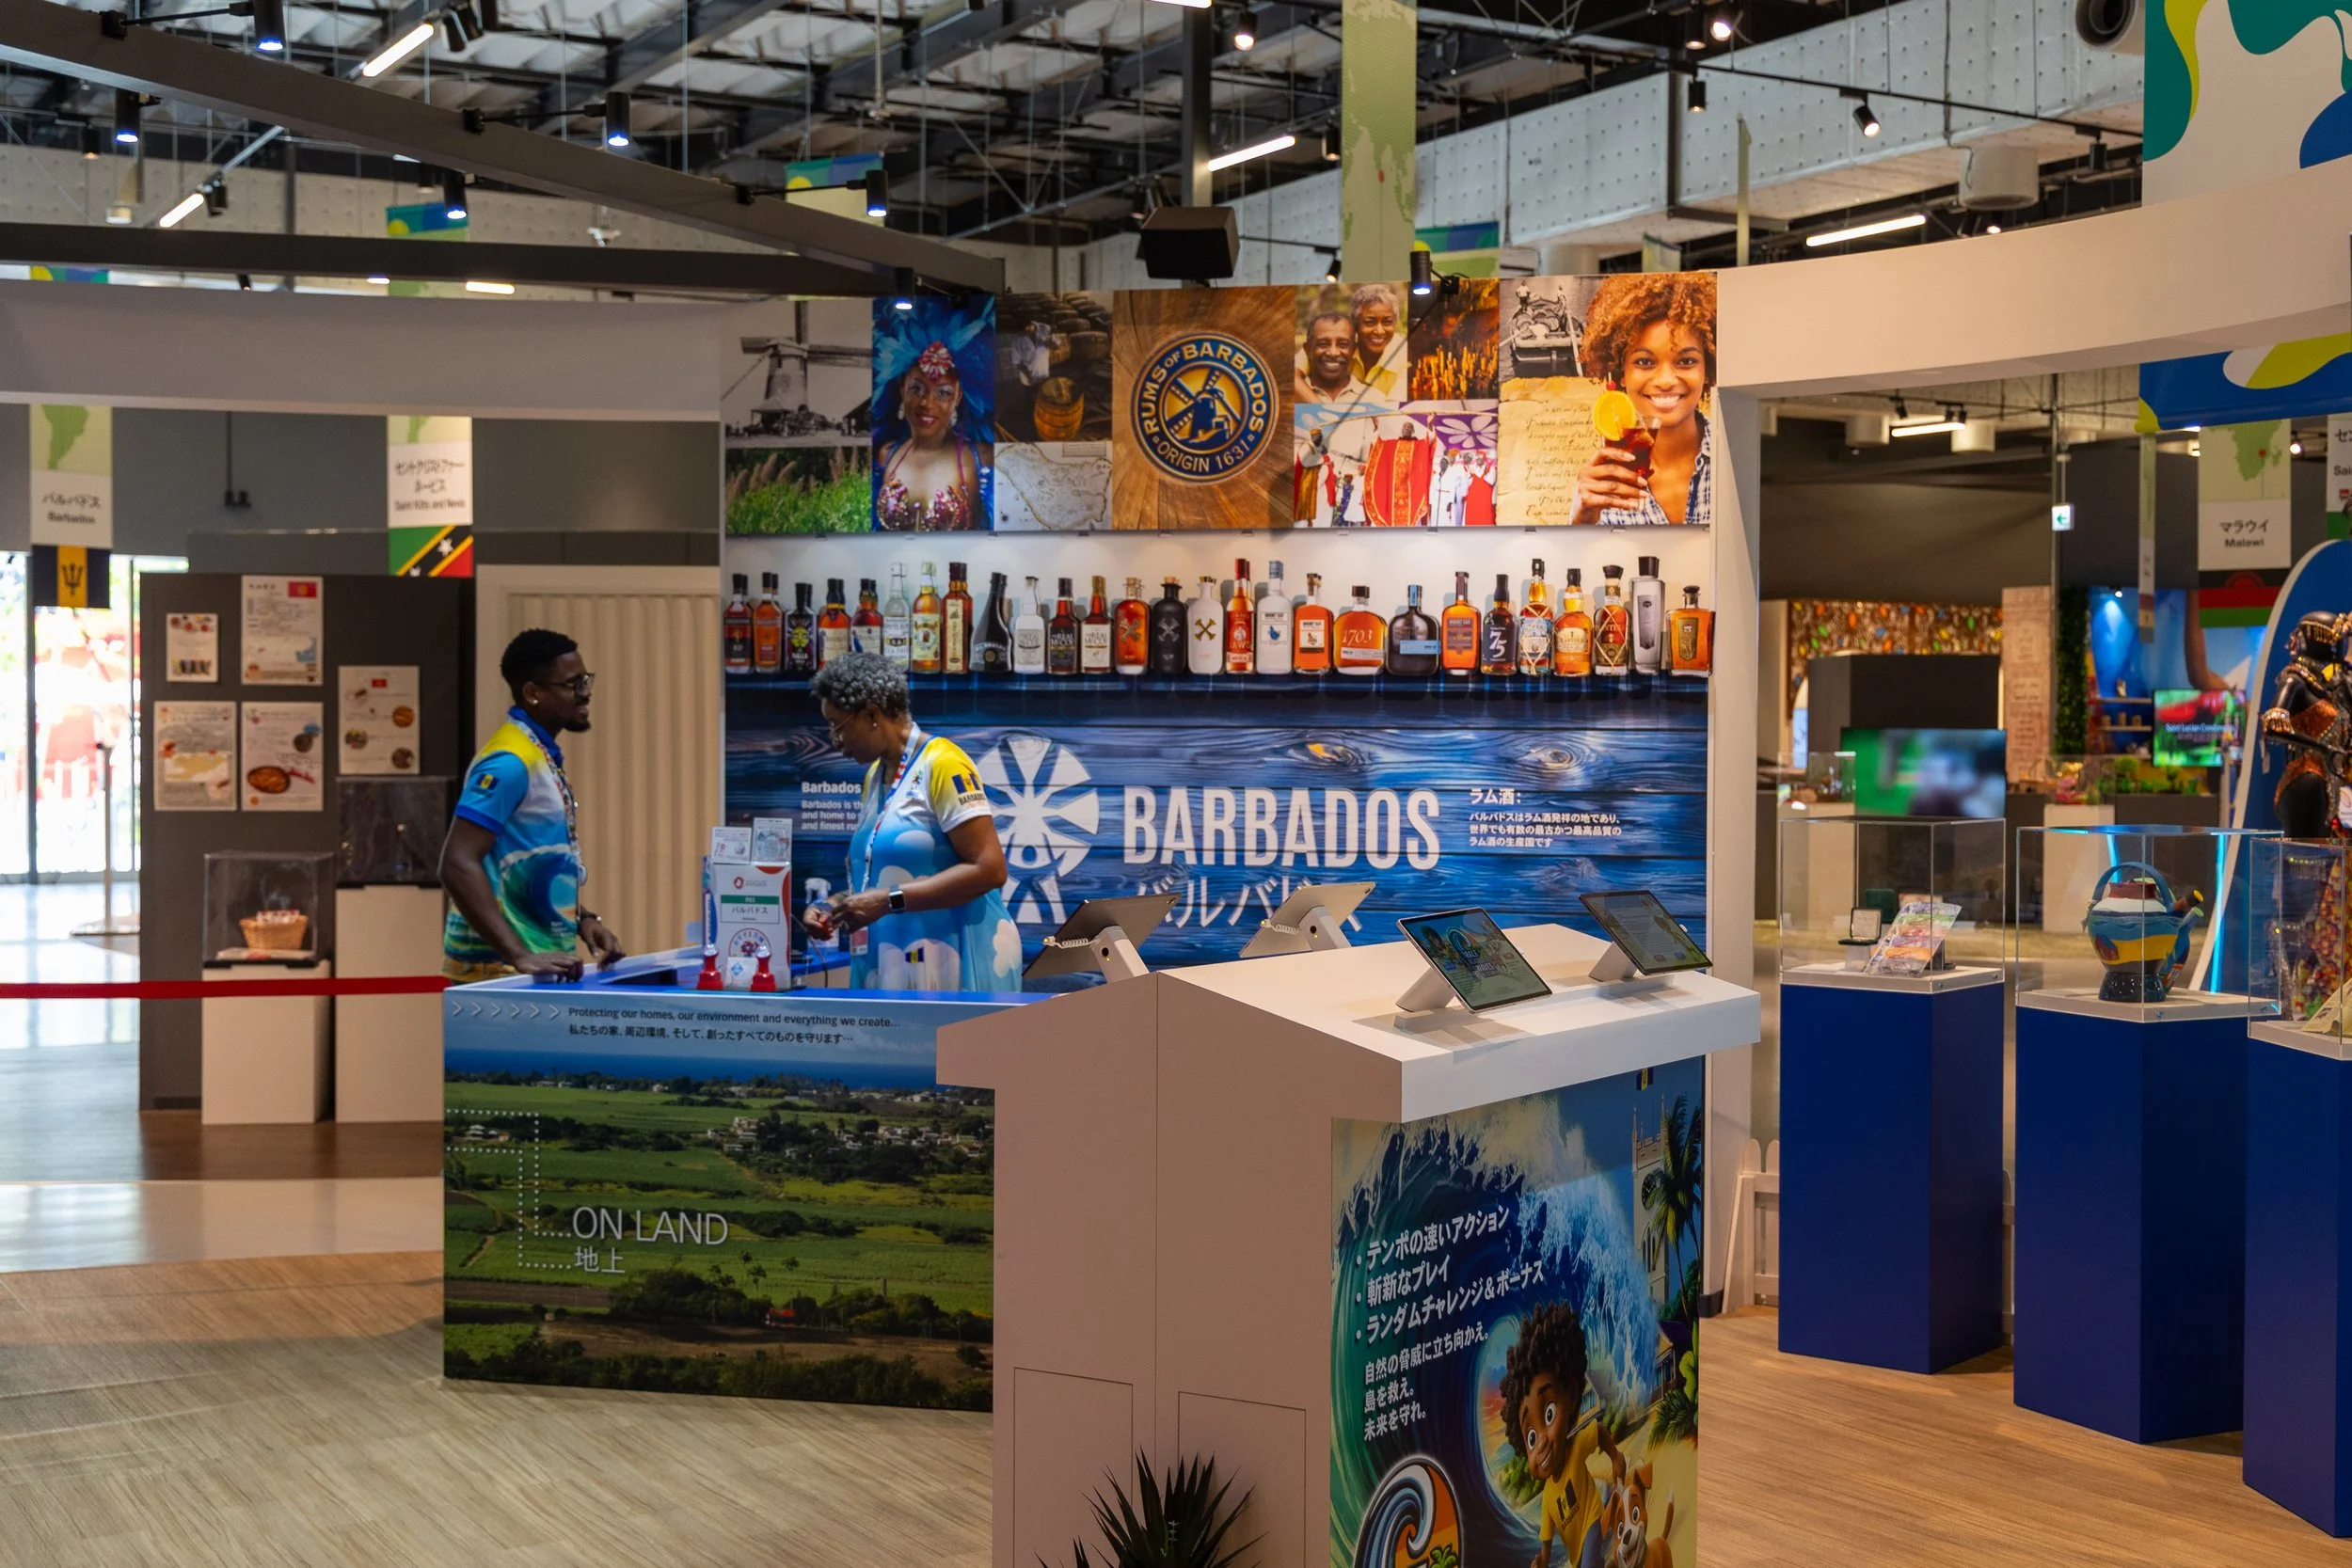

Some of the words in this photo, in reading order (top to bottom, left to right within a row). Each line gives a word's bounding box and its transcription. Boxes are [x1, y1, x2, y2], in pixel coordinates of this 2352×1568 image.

[1140, 365, 1168, 436] RUMS
[1164, 352, 1181, 369] OF
[1181, 341, 1267, 433] BARBADOS
[1156, 440, 1210, 472] ORIGIN
[1215, 439, 1250, 469] 1631
[2220, 519, 2269, 534] マラウイ
[2225, 537, 2265, 547] Malawi
[1343, 629, 1373, 646] 1703
[1489, 631, 1507, 657] 75
[802, 781, 862, 794] Barbados
[802, 800, 842, 810] Barbados
[844, 800, 852, 810] is
[802, 811, 818, 820] and
[819, 811, 845, 820] home
[802, 822, 818, 831] and
[819, 822, 845, 831] finest
[1123, 784, 1440, 870] BARBADOS
[1470, 836, 1553, 847] ラム酒の生産国です
[731, 906, 769, 915] バルバドス
[568, 1007, 619, 1020] Protecting
[621, 1009, 638, 1019] our
[640, 1008, 675, 1021] homes,
[677, 1011, 695, 1021] our
[697, 1012, 759, 1024] environment
[762, 1014, 782, 1023] and
[784, 1015, 837, 1027] everything
[572, 1206, 623, 1241] ON
[635, 1209, 729, 1246] LAND
[1366, 1204, 1510, 1271] テンポの速いアクション
[574, 1245, 626, 1275] 地上
[1366, 1253, 1451, 1308] 斬新なプレイ
[1365, 1321, 1489, 1386] 自然の脅威に立ち向かえ。
[1364, 1376, 1415, 1414] 島を救え。
[1364, 1401, 1427, 1442] 未来を守れ。
